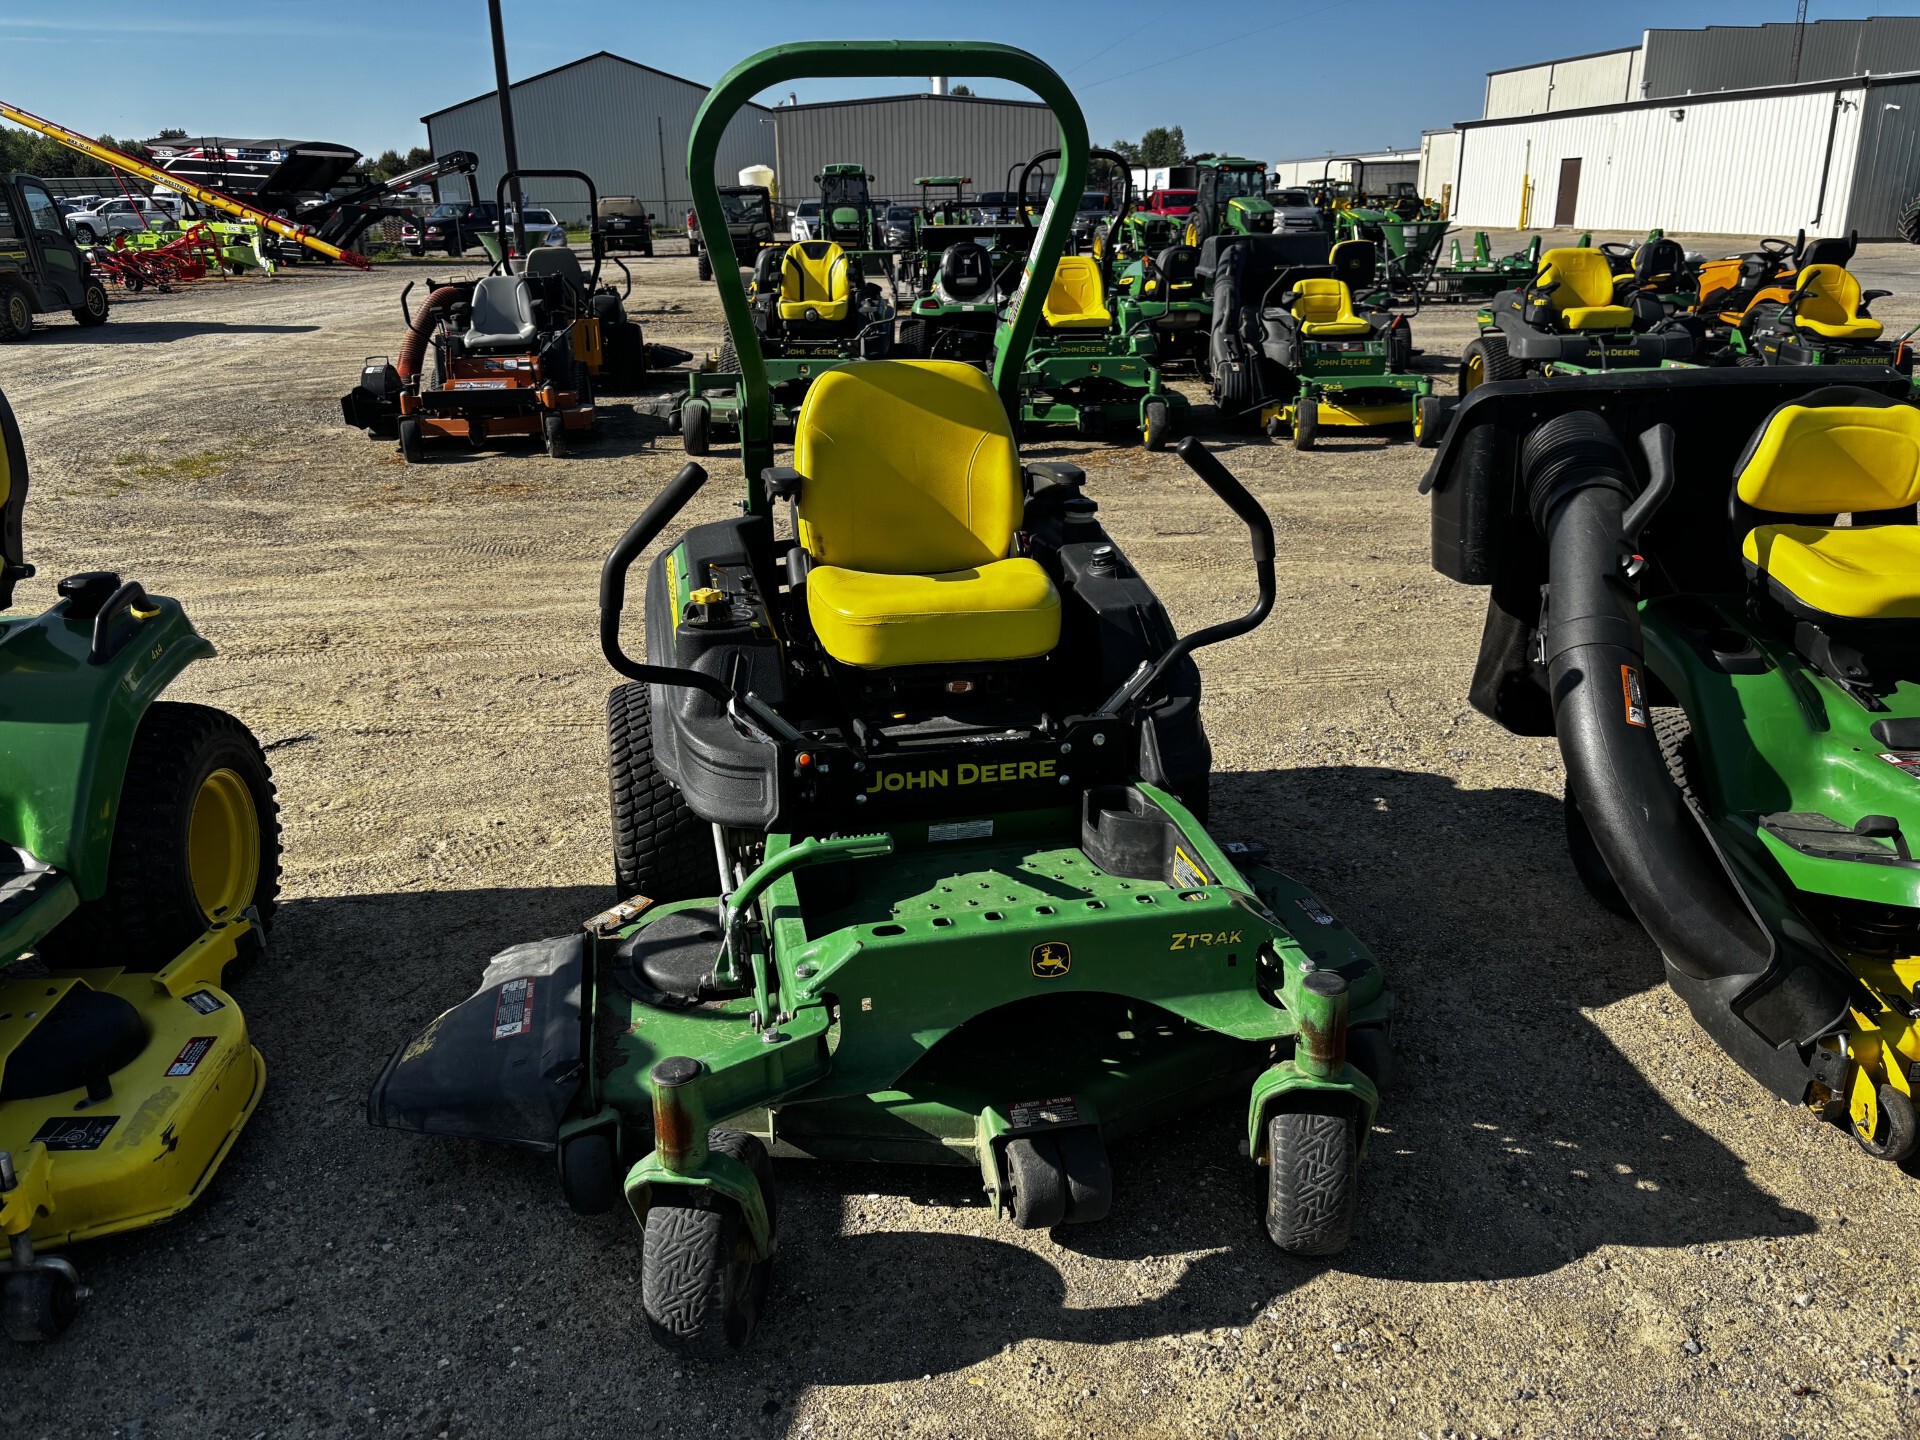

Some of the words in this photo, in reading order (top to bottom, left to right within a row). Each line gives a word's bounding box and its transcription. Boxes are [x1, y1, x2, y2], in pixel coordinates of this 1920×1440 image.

[1080, 345, 1107, 353] DEERE
[1610, 349, 1640, 357] DEERE
[1340, 358, 1372, 366] DEERE
[866, 769, 949, 793] JOHN
[957, 759, 1057, 785] DEERE
[1169, 929, 1244, 951] ZTRAK
